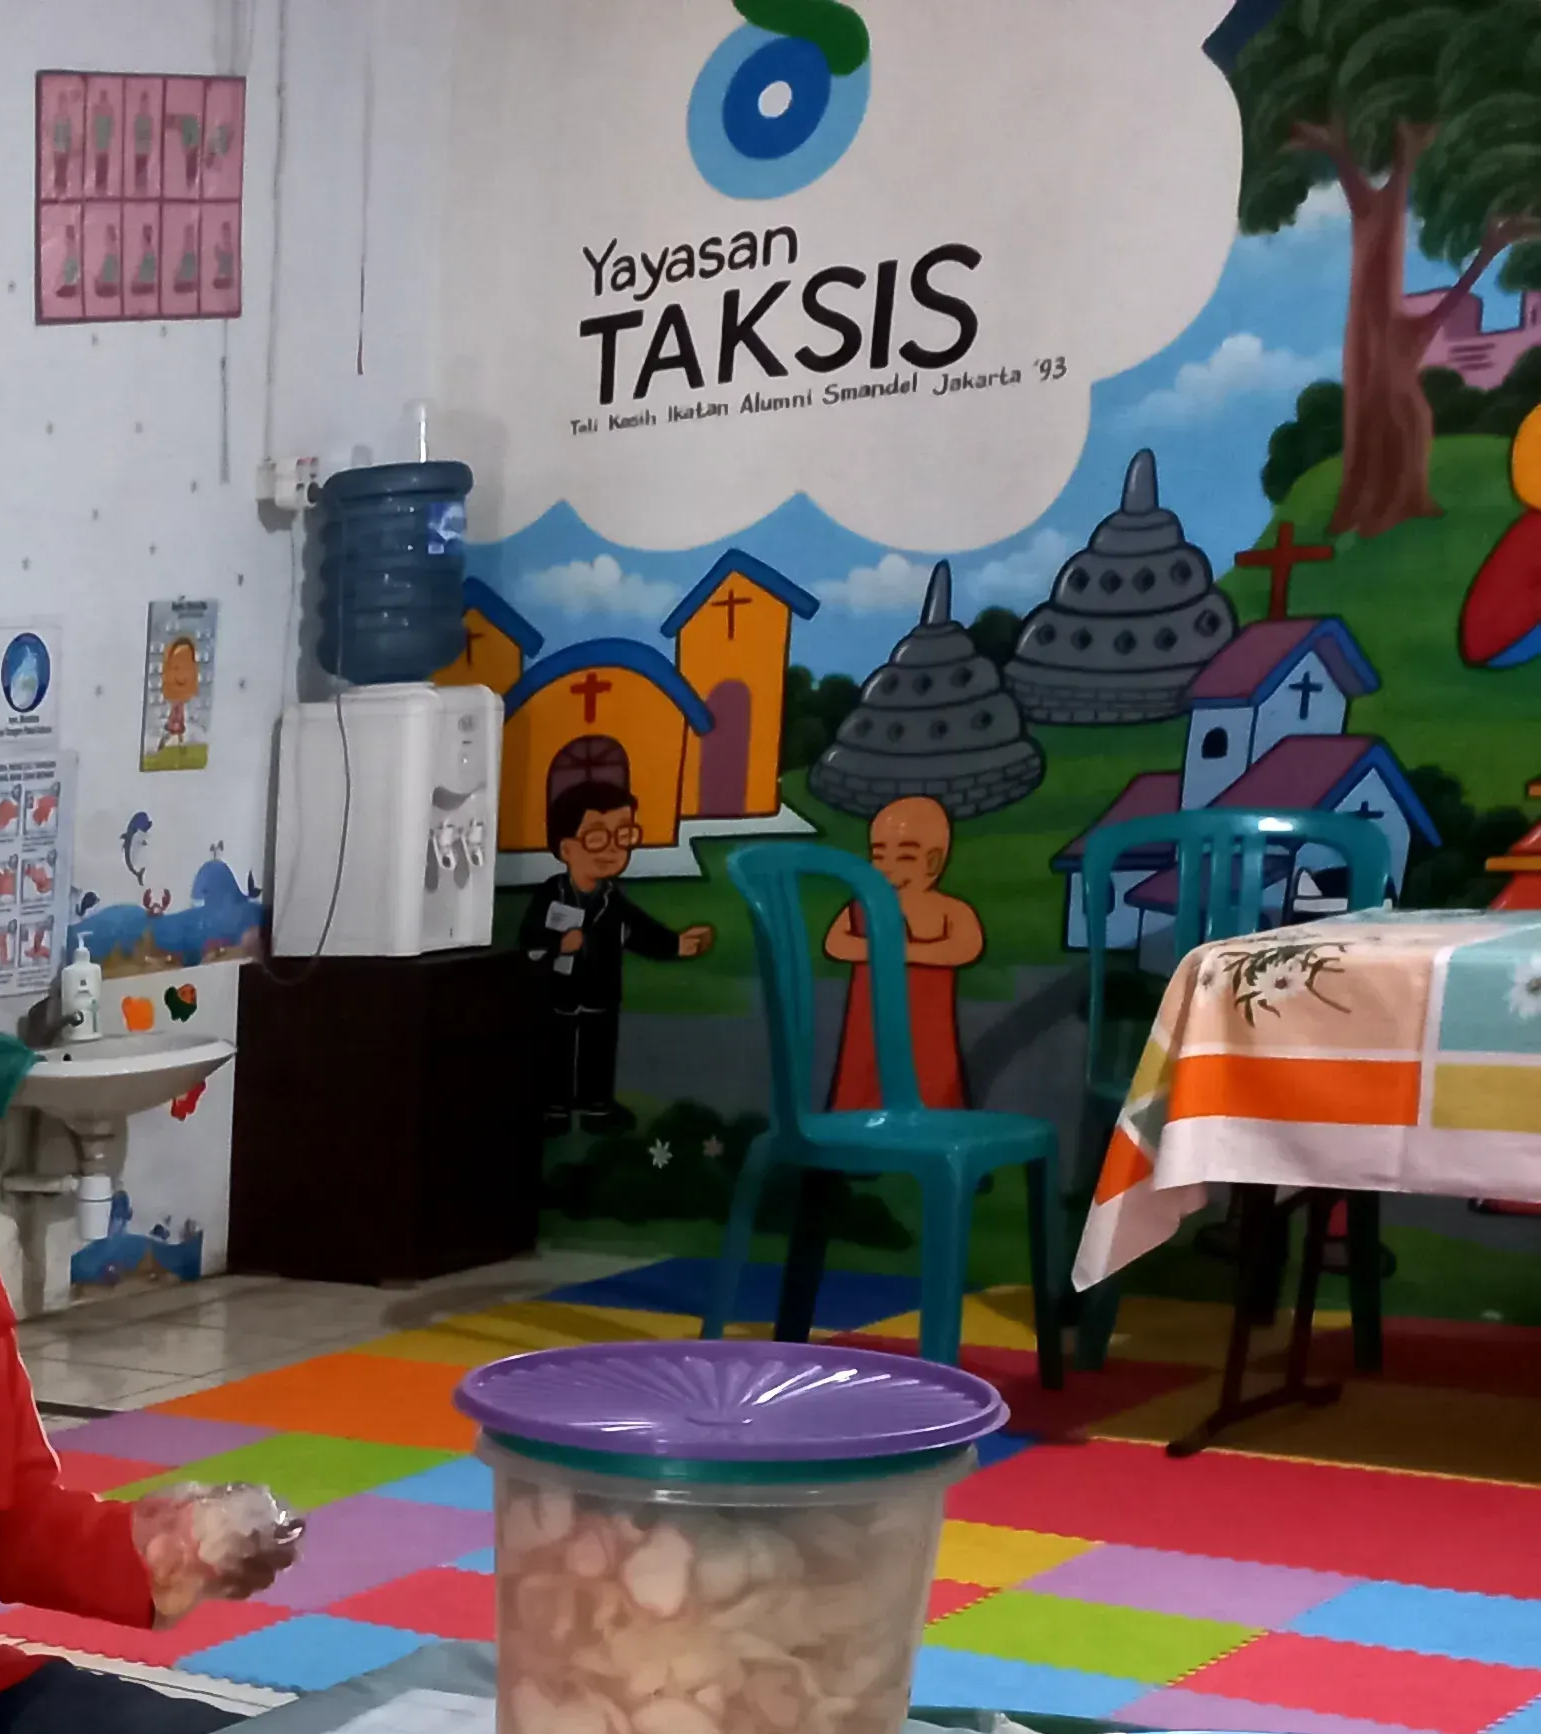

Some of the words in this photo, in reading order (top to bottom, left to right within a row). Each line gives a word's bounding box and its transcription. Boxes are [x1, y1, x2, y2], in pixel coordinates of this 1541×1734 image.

[582, 225, 799, 302] Yayasan
[579, 243, 983, 405] TAKSIS
[668, 401, 729, 423] Ikatan
[739, 388, 813, 415] Alumni
[821, 371, 918, 405] Smandel
[932, 366, 1022, 396] Jakarta
